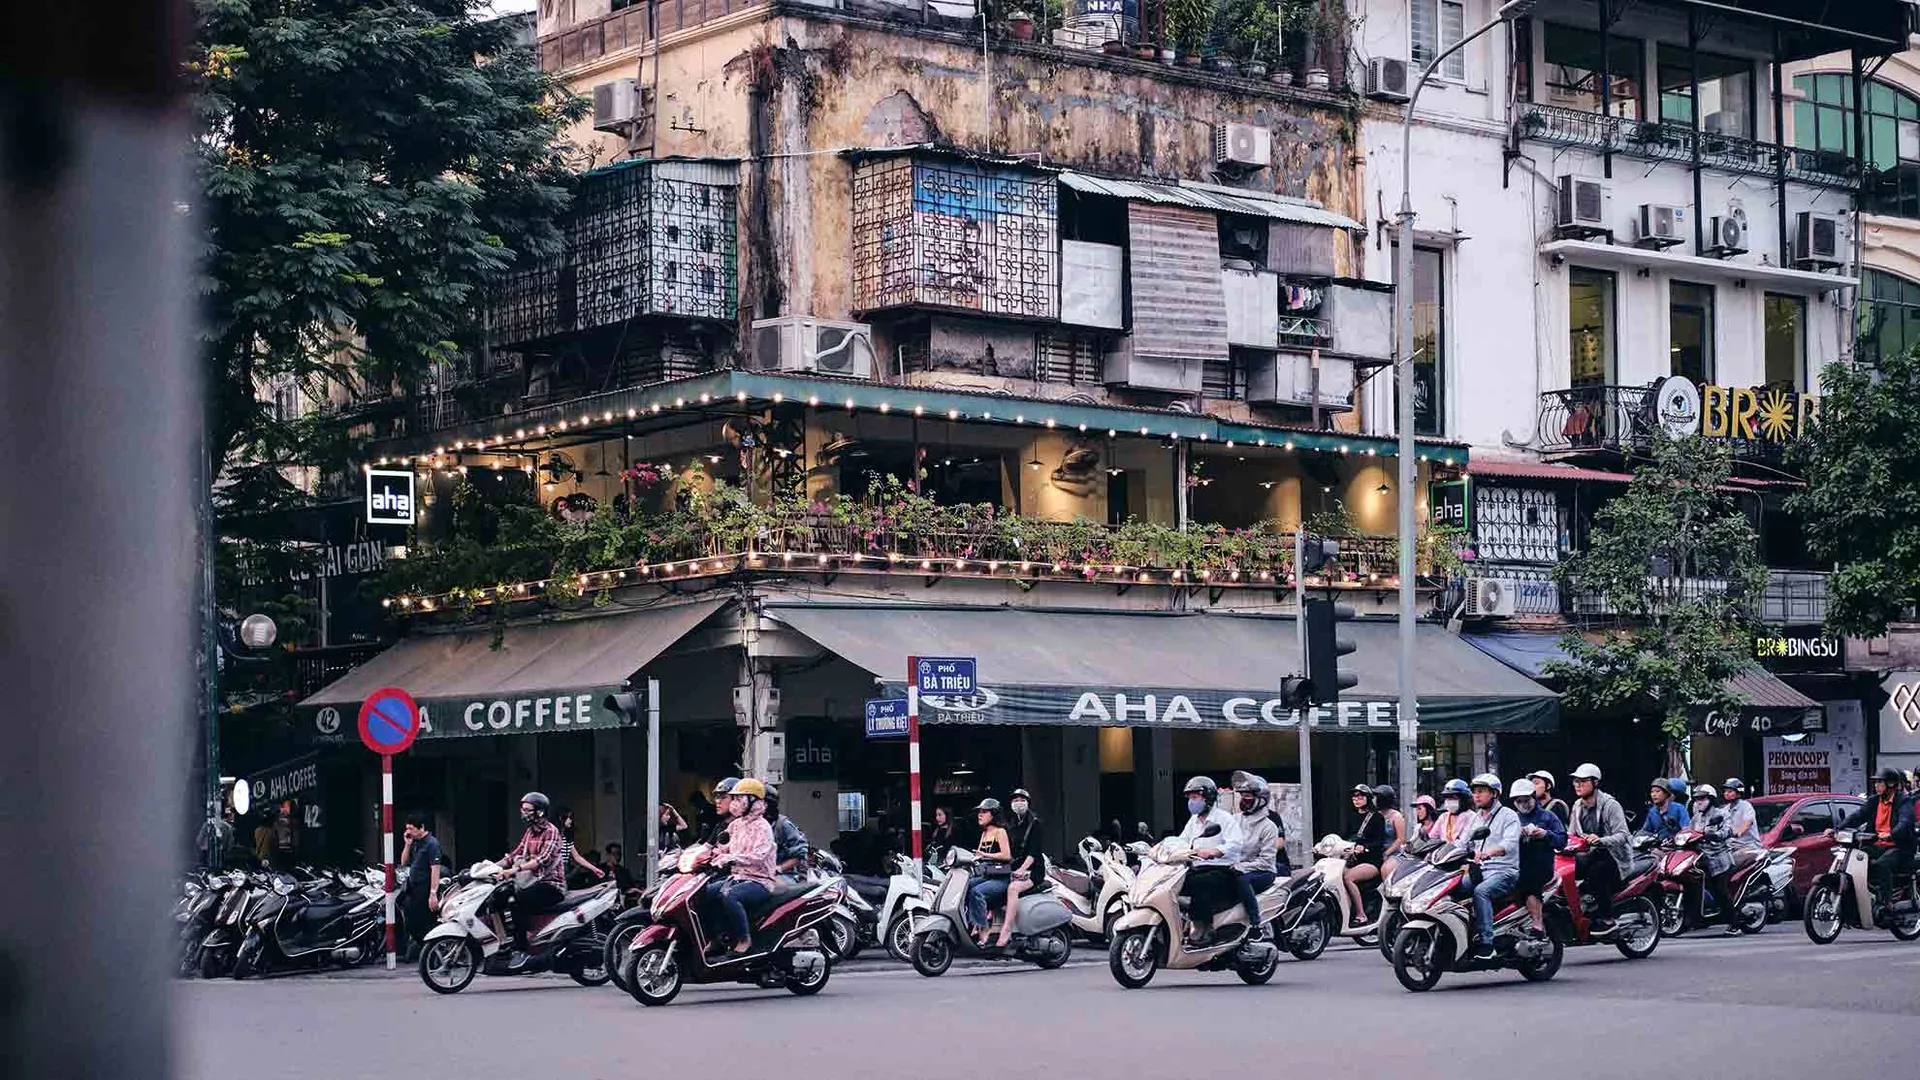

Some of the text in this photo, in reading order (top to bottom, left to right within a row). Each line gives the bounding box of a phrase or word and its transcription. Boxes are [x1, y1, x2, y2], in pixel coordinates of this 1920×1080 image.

[372, 485, 409, 510] aha
[1435, 496, 1463, 519] aha
[937, 662, 956, 673] PHỐ
[923, 673, 970, 692] BÀ TRIỆU
[464, 694, 593, 731] COFFEE
[1069, 692, 1203, 723] AHA
[321, 710, 336, 730] 42
[795, 738, 831, 763] aha
[1768, 751, 1830, 766] PHOTOCOPY
[270, 774, 288, 800] AHA
[288, 763, 317, 793] COFFEE
[304, 804, 321, 828] 42
